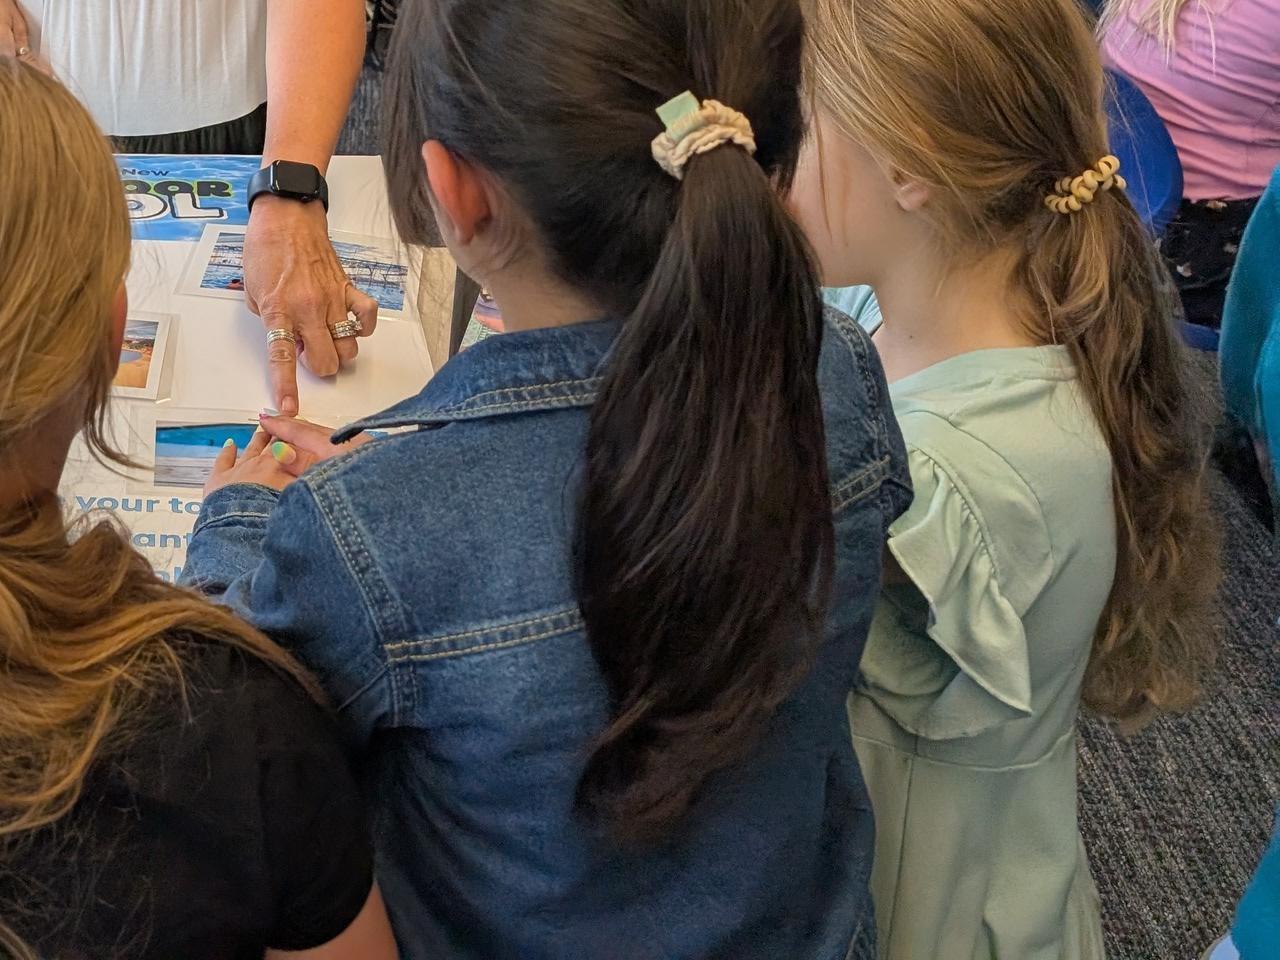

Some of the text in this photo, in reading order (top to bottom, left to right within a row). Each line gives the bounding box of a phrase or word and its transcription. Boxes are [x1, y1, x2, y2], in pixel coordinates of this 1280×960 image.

[121, 168, 169, 177] New
[120, 179, 232, 197] OOR
[75, 495, 160, 514] your
[132, 532, 193, 549] ant
